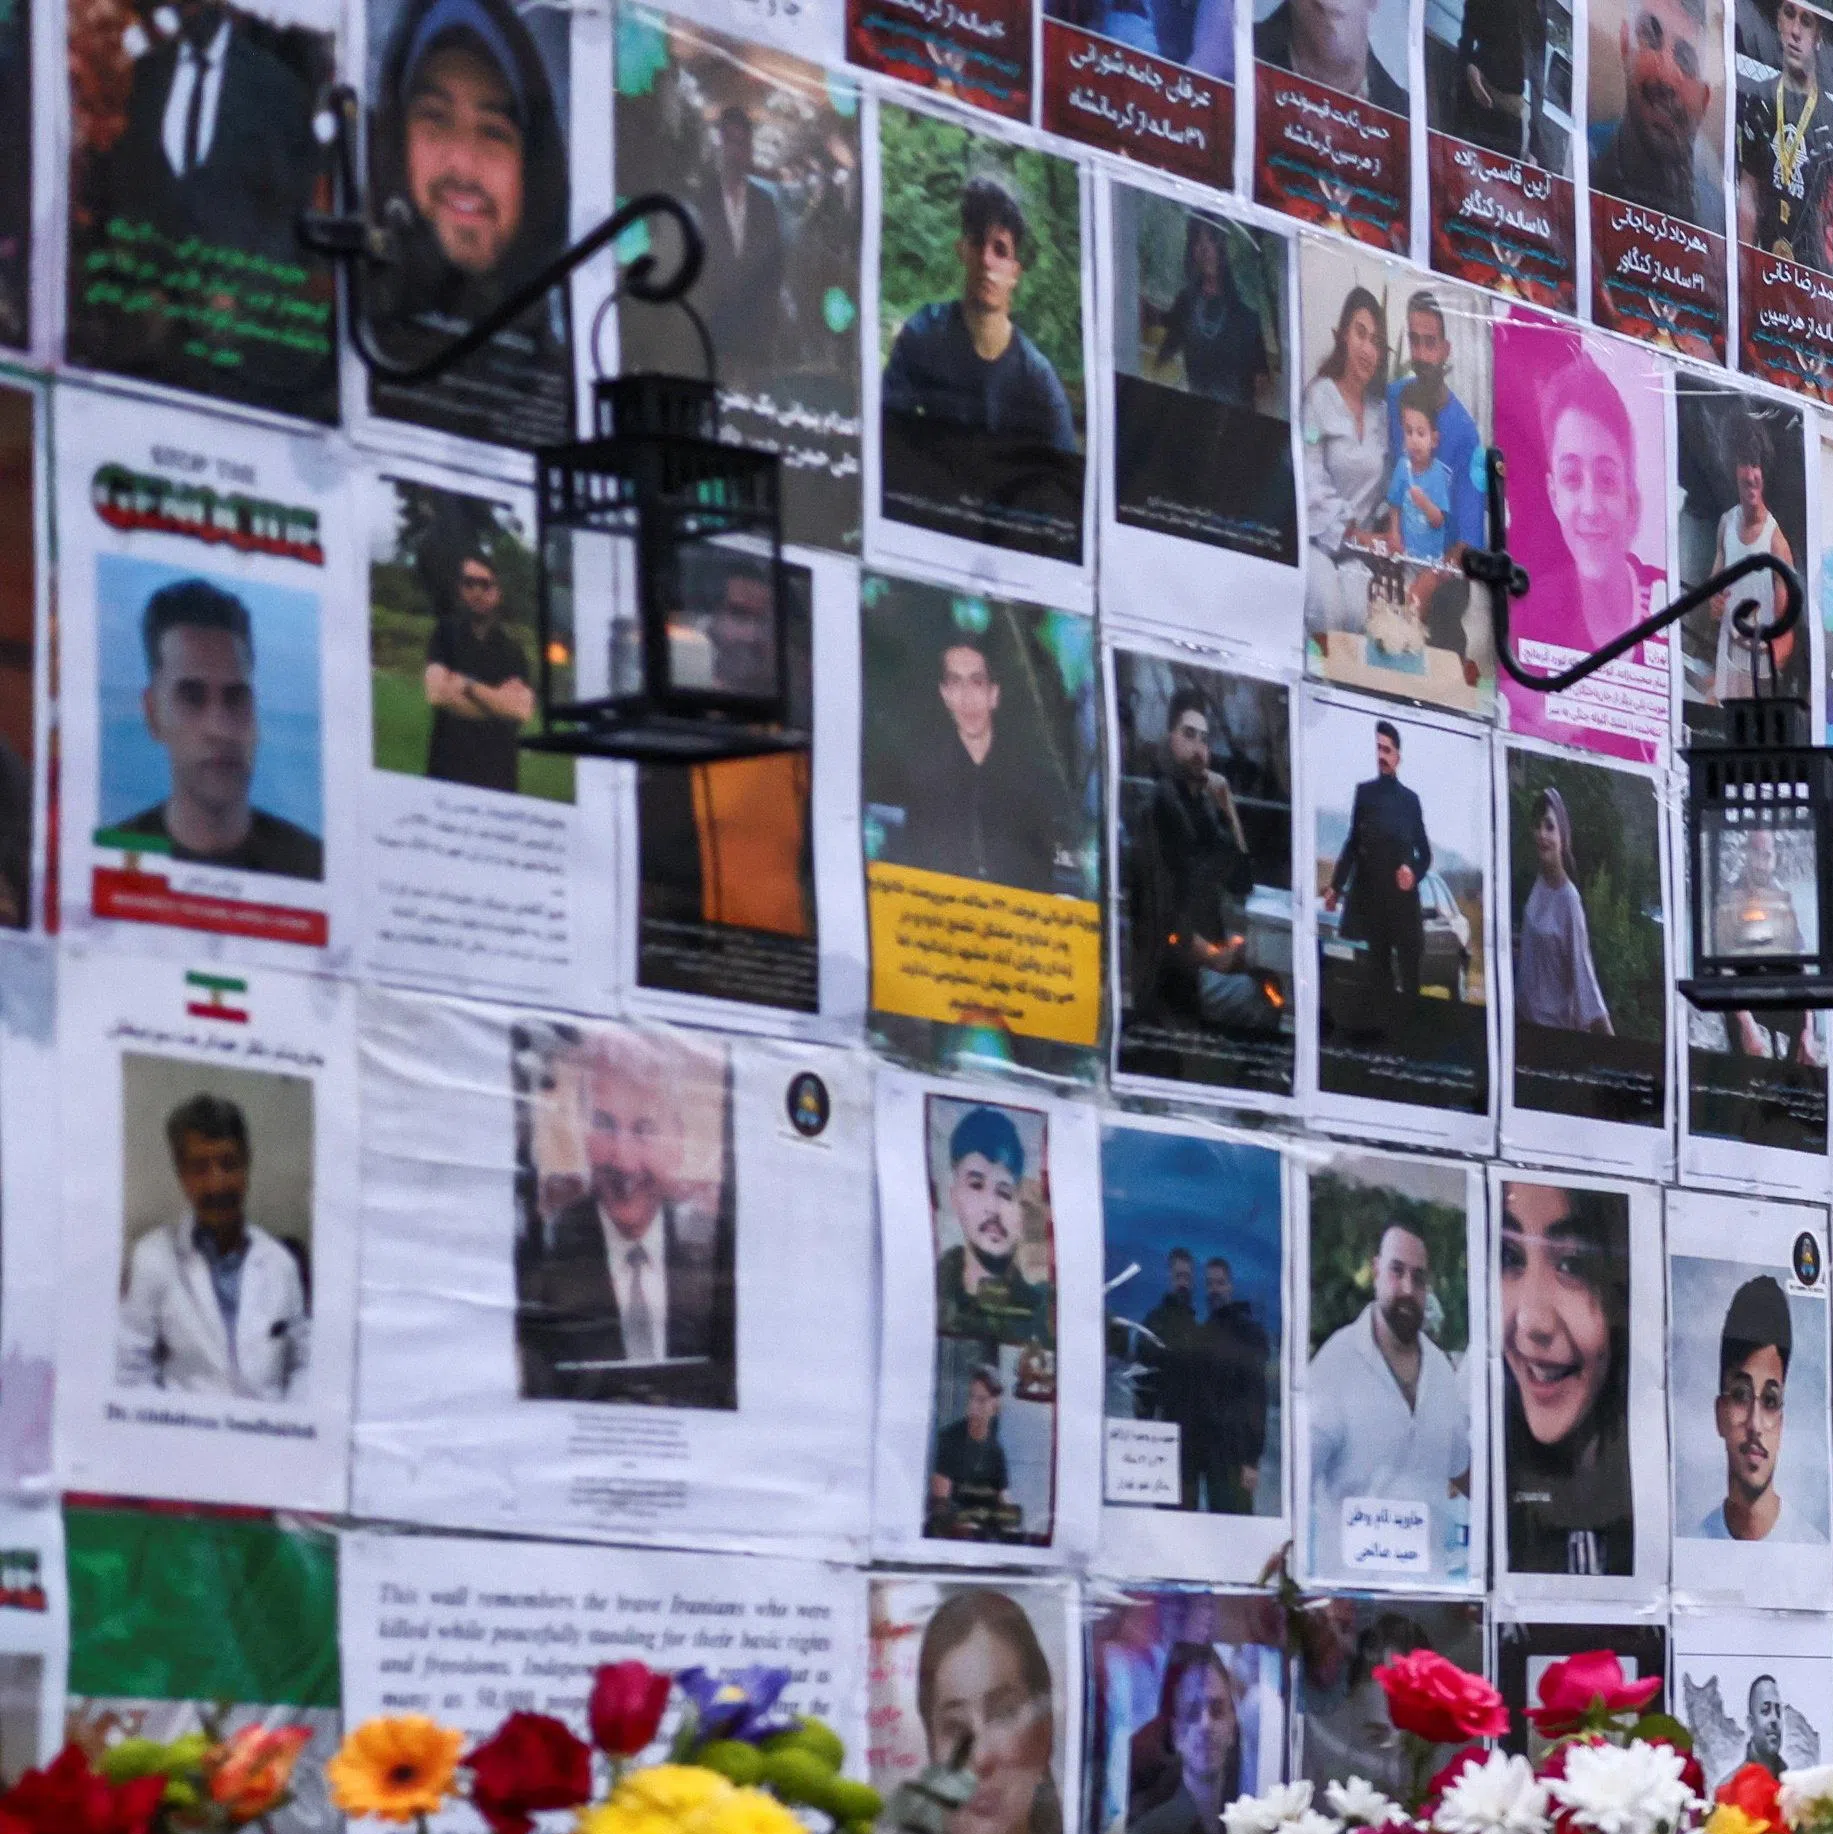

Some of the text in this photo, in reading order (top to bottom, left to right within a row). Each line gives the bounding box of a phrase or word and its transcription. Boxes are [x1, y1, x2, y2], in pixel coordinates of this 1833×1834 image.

[584, 1590, 608, 1612] the
[755, 1597, 787, 1619] who
[378, 1618, 430, 1640] killed
[437, 1621, 486, 1642] while
[491, 1622, 580, 1647] peacefully
[662, 1626, 686, 1649] for
[693, 1629, 732, 1649] their
[740, 1630, 781, 1651] basic
[787, 1631, 830, 1655] rights
[380, 1655, 414, 1675] and
